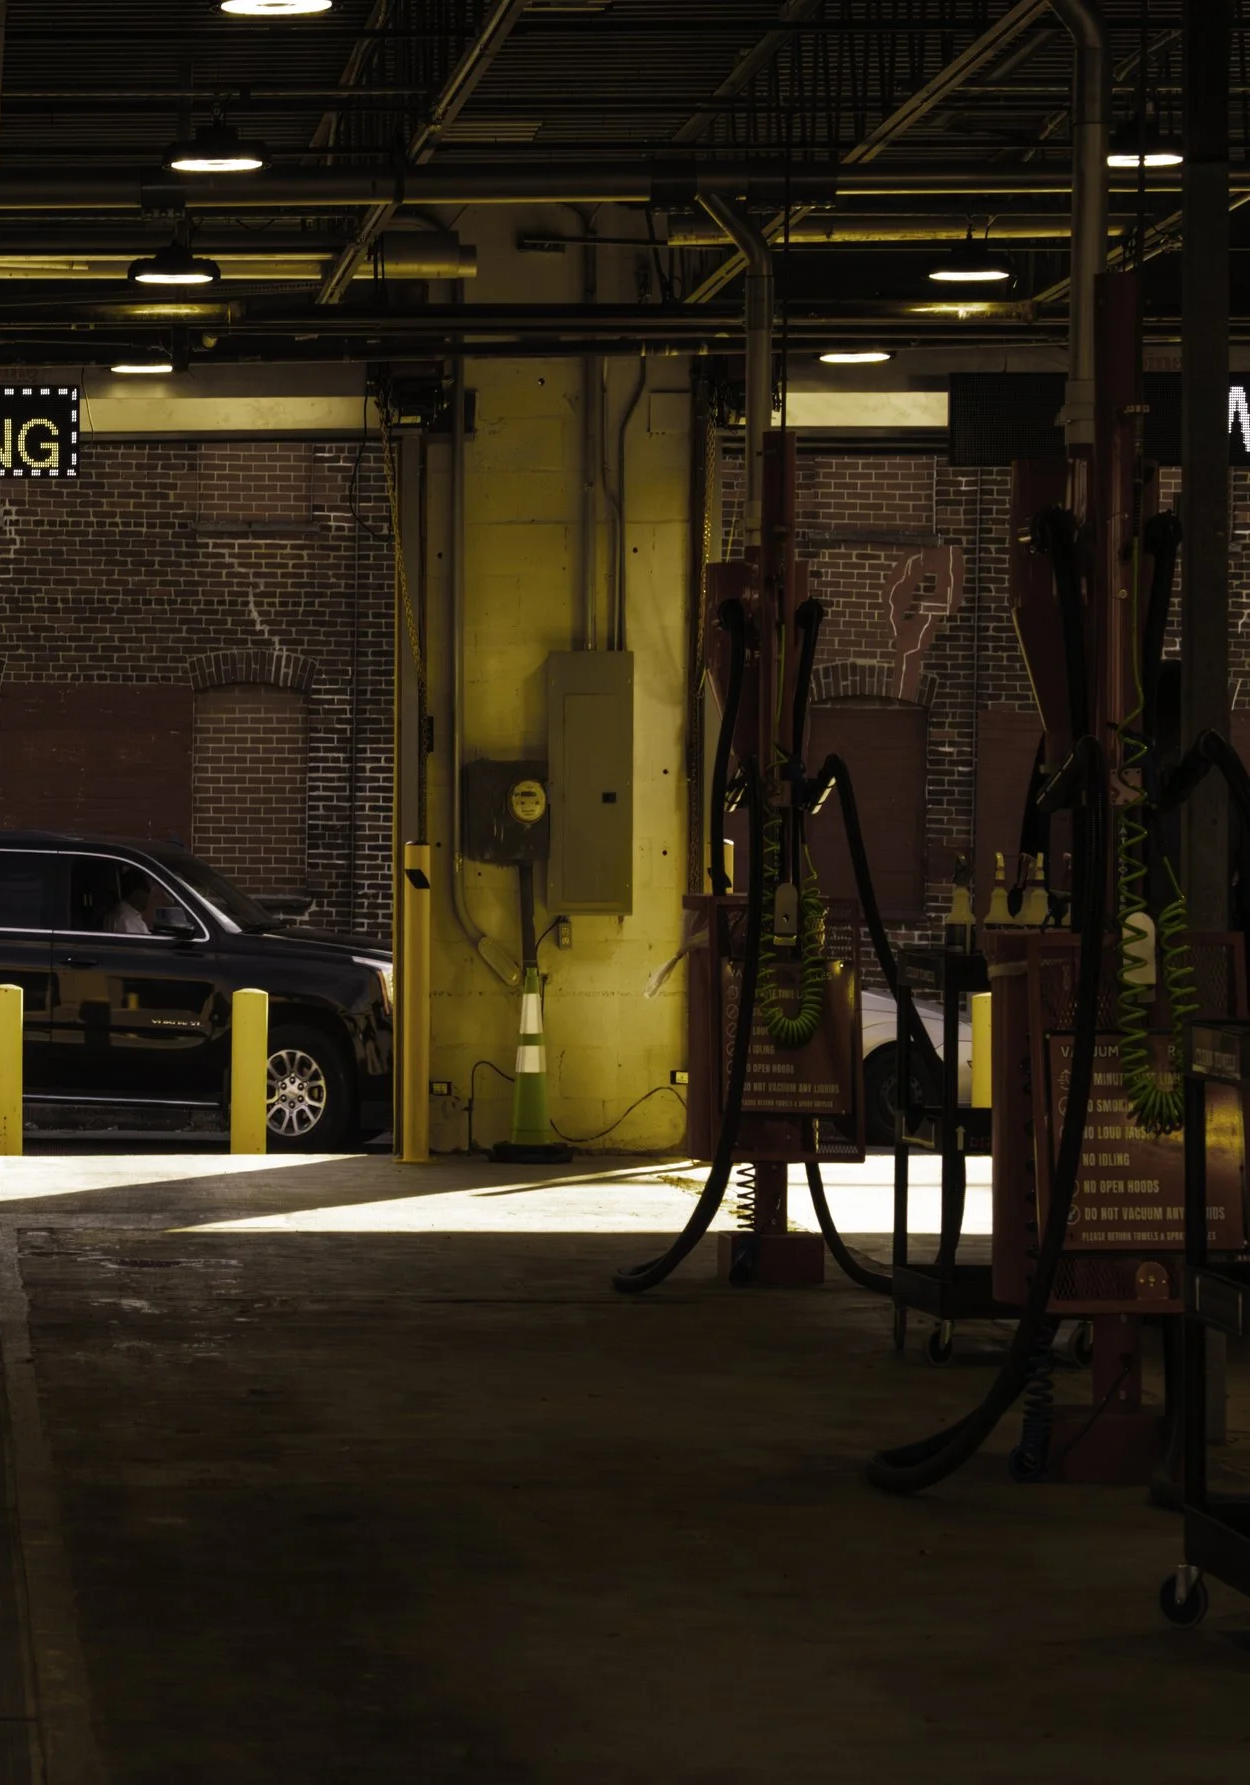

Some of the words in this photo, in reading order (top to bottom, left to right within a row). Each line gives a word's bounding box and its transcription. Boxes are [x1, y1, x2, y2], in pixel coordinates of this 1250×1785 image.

[1098, 1126, 1121, 1139] LOUD
[1082, 1153, 1094, 1166] NO
[1099, 1153, 1130, 1166] IDLING
[1083, 1180, 1096, 1193] NO
[1101, 1180, 1124, 1193] OPEN
[1127, 1180, 1159, 1194] HOODS
[1084, 1207, 1097, 1220] DO
[1101, 1207, 1119, 1220] NOT
[1123, 1207, 1163, 1220] VACUUM
